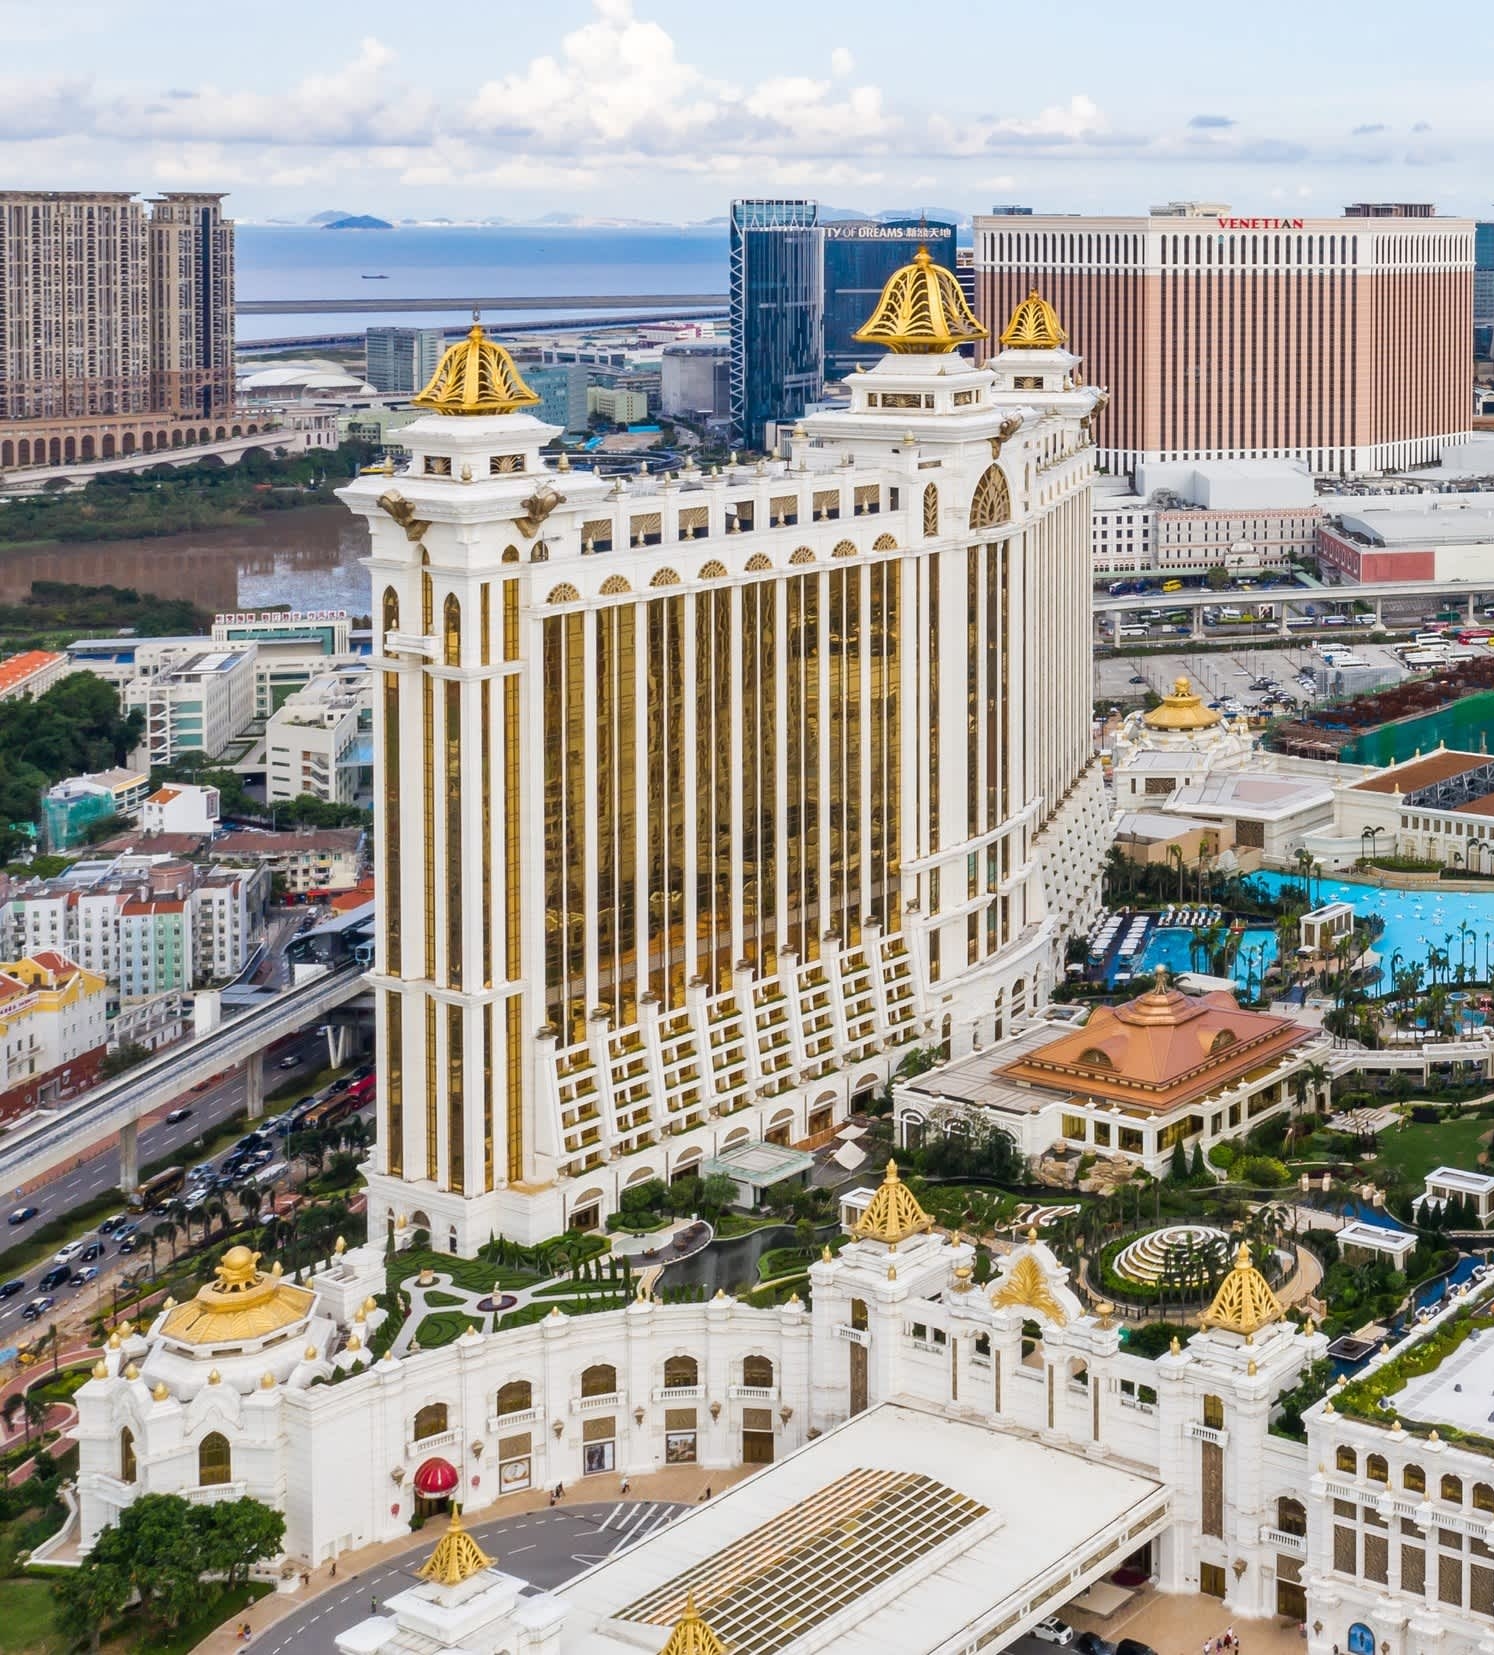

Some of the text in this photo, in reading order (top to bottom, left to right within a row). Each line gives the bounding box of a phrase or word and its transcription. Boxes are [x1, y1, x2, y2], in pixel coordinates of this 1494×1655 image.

[1217, 218, 1304, 229] VENETIAN
[824, 227, 904, 238] TY OF DREAMS
